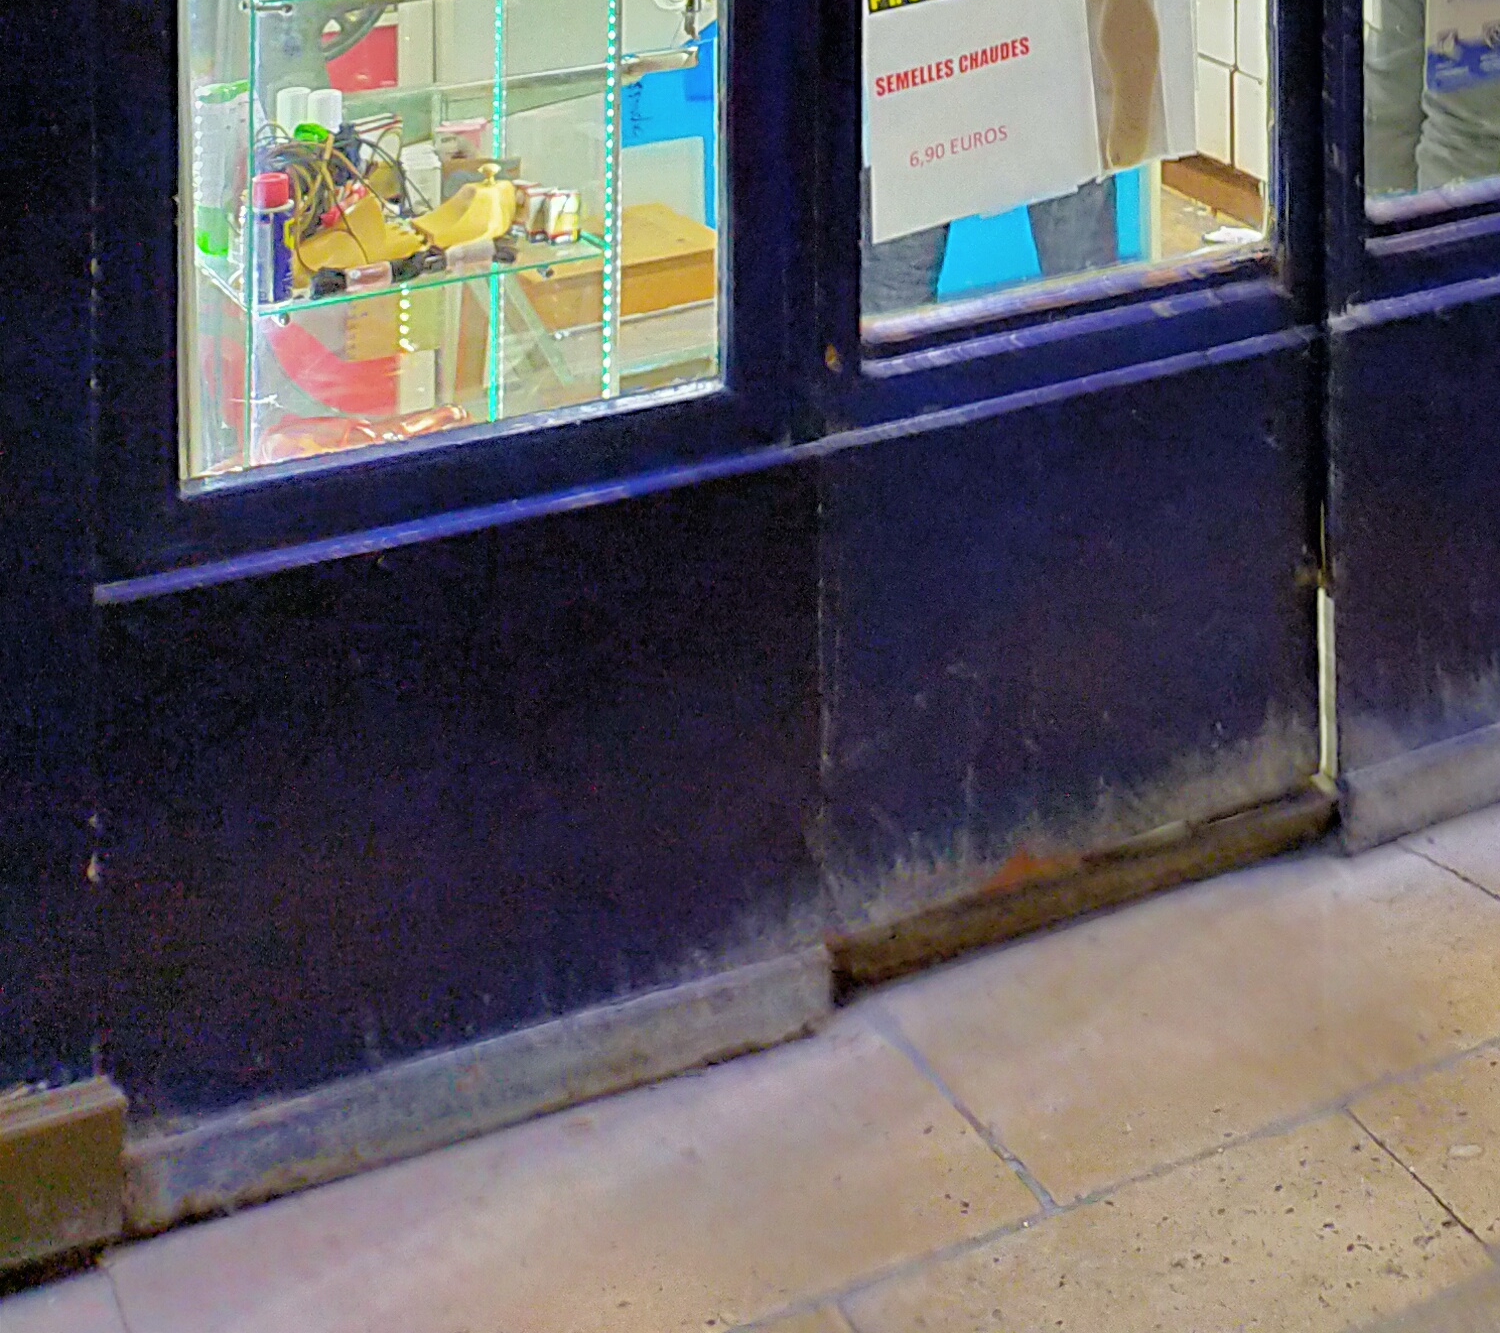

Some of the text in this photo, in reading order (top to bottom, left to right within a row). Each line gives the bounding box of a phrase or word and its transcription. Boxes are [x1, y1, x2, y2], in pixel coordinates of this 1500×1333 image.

[875, 37, 1031, 97] SEMELLES CHAUDES
[909, 125, 1009, 169] 6,90 EUROS
